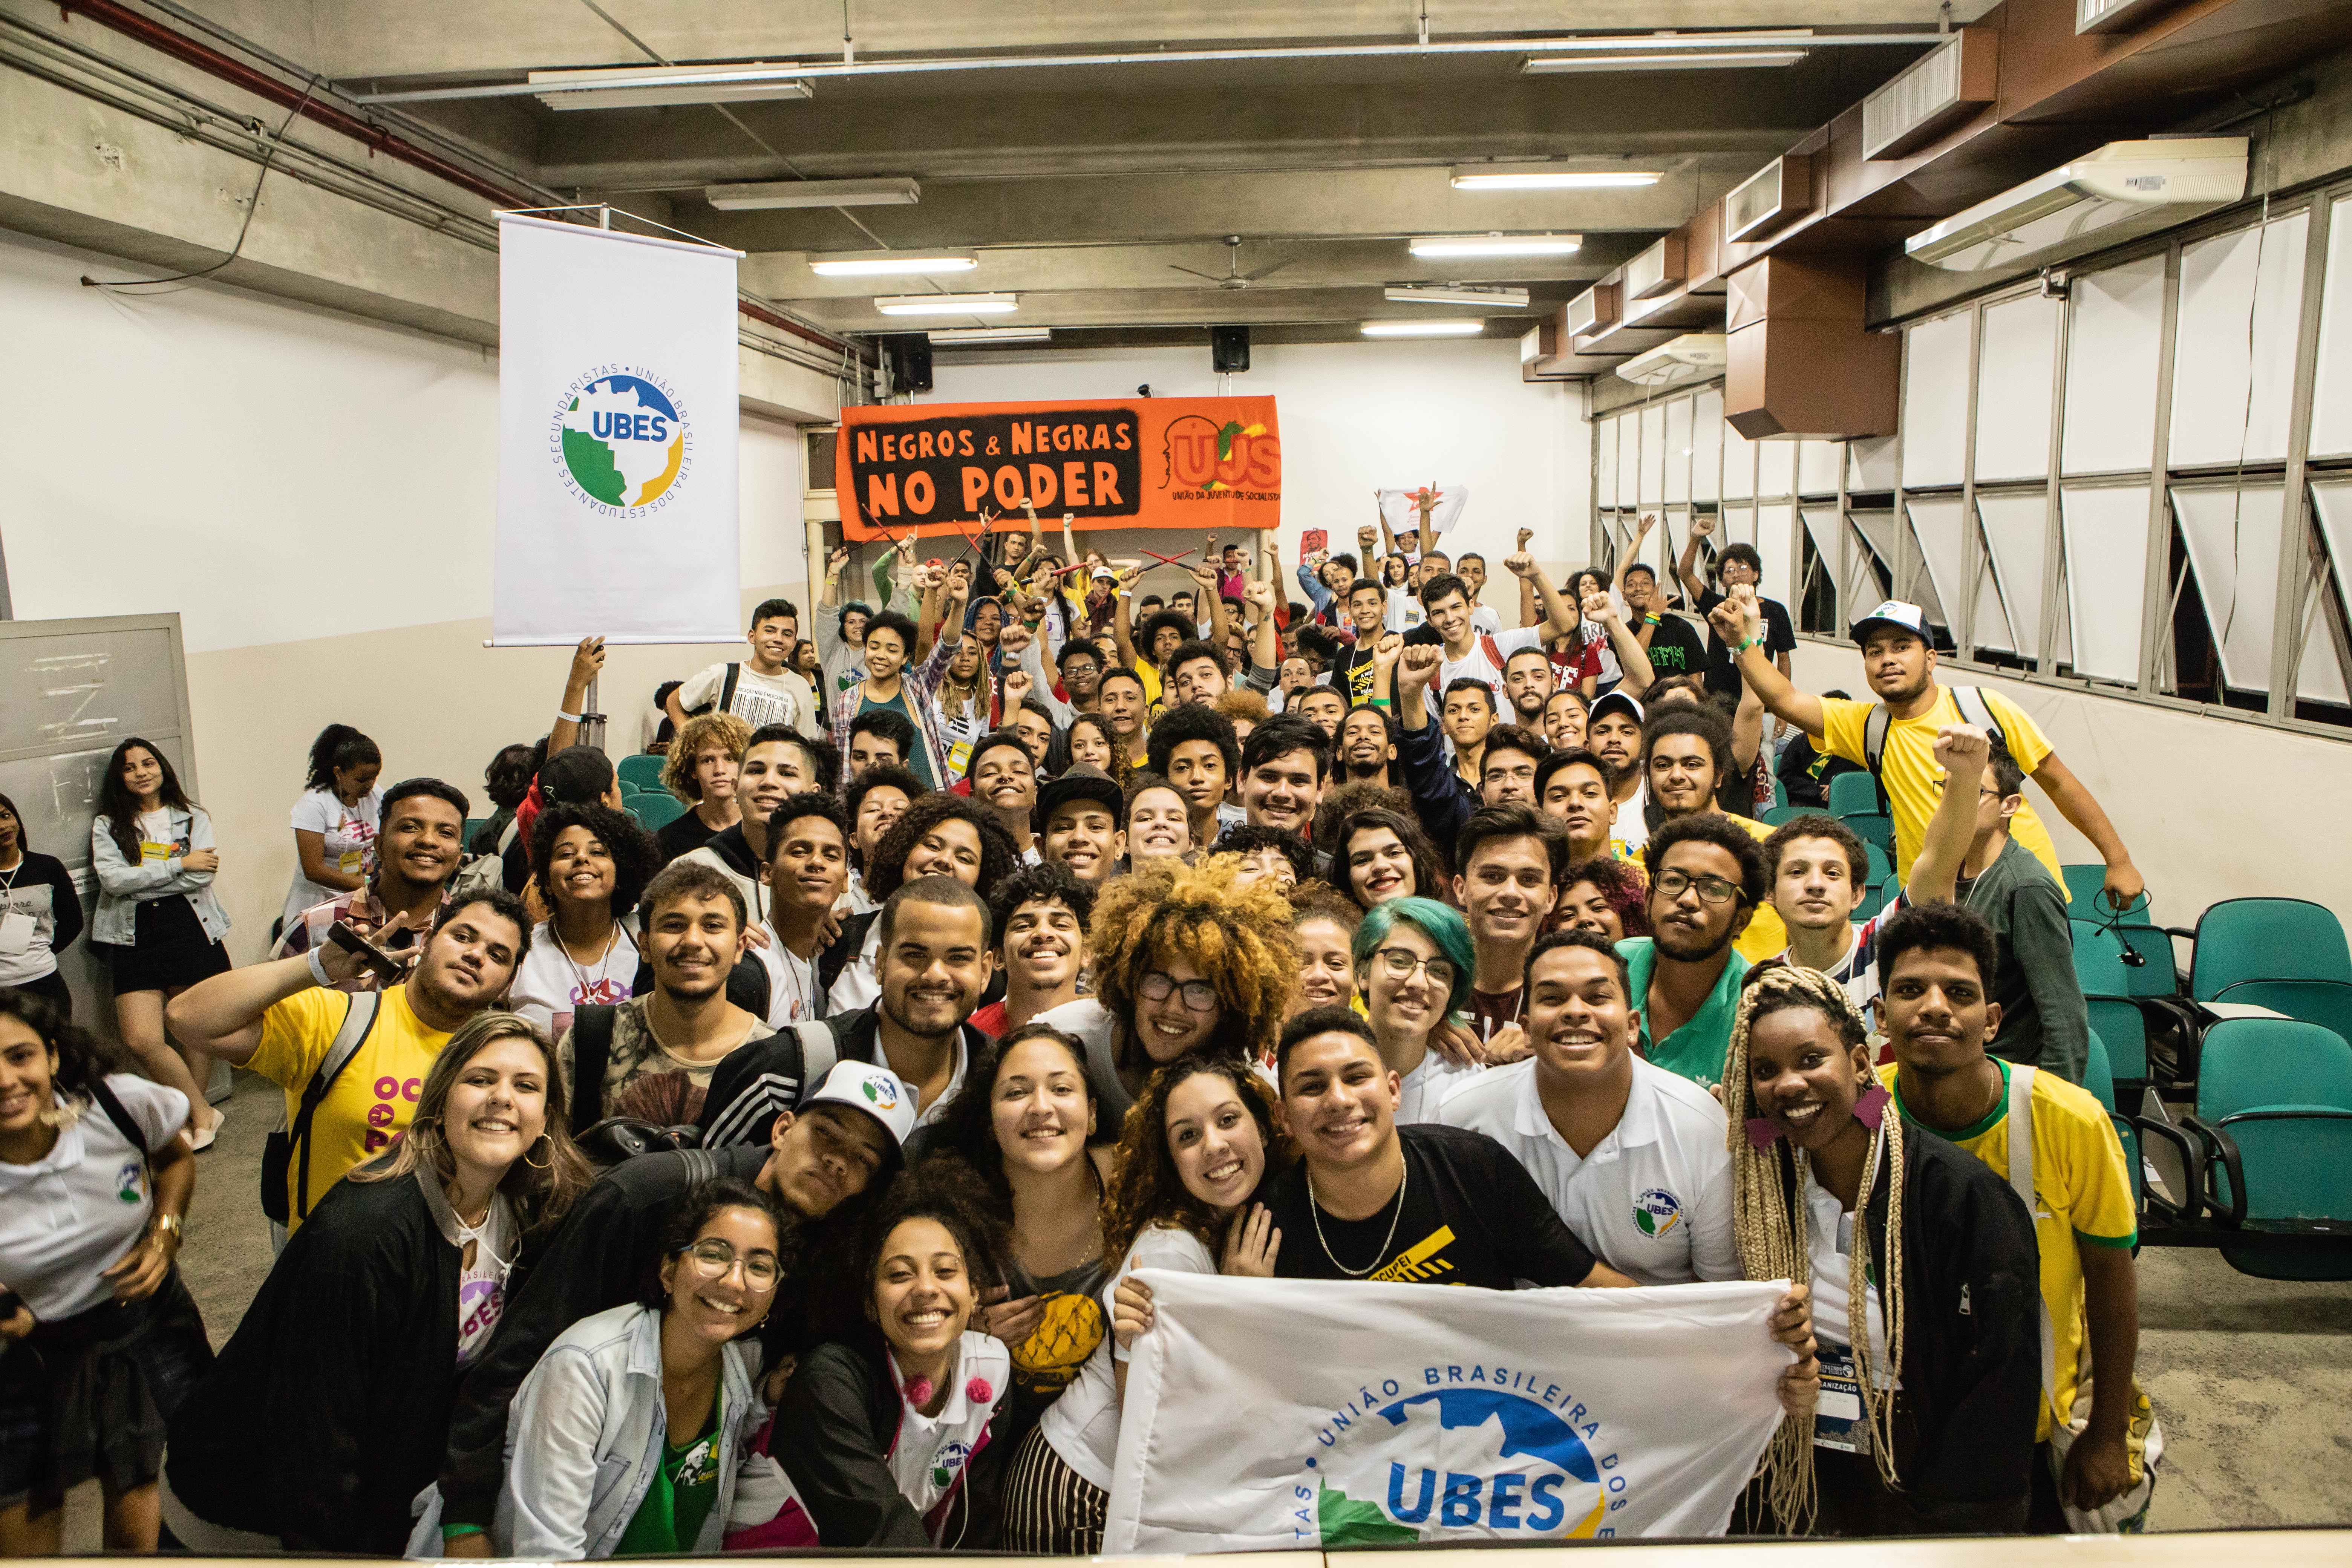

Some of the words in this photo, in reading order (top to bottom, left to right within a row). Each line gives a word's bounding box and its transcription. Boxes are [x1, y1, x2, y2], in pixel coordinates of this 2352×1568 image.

[636, 366, 674, 398] UNIÃO
[550, 363, 618, 464] SECUNDARISTAS
[593, 410, 668, 442] UBES
[674, 400, 693, 489] BRASILEIRA
[857, 429, 975, 463] NEGROS
[986, 436, 1000, 456] &
[1012, 421, 1132, 455] NEGRAS
[1173, 433, 1281, 488] UJS
[559, 469, 646, 519] ESTUDANTES
[651, 490, 674, 512] DOS
[868, 470, 936, 518] NO
[962, 461, 1124, 512] PODER
[1172, 490, 1194, 501] UNIÃO
[1196, 490, 1205, 500] DA
[1647, 1204, 1674, 1215] UBES
[459, 1293, 502, 1337] BES
[1822, 1381, 1857, 1392] ANIZAÇÃO
[1317, 1379, 1399, 1447] UNIÃO
[1424, 1364, 1599, 1439] BRASILEIRA
[1601, 1453, 1627, 1511] DOS
[1388, 1461, 1565, 1531] UBES
